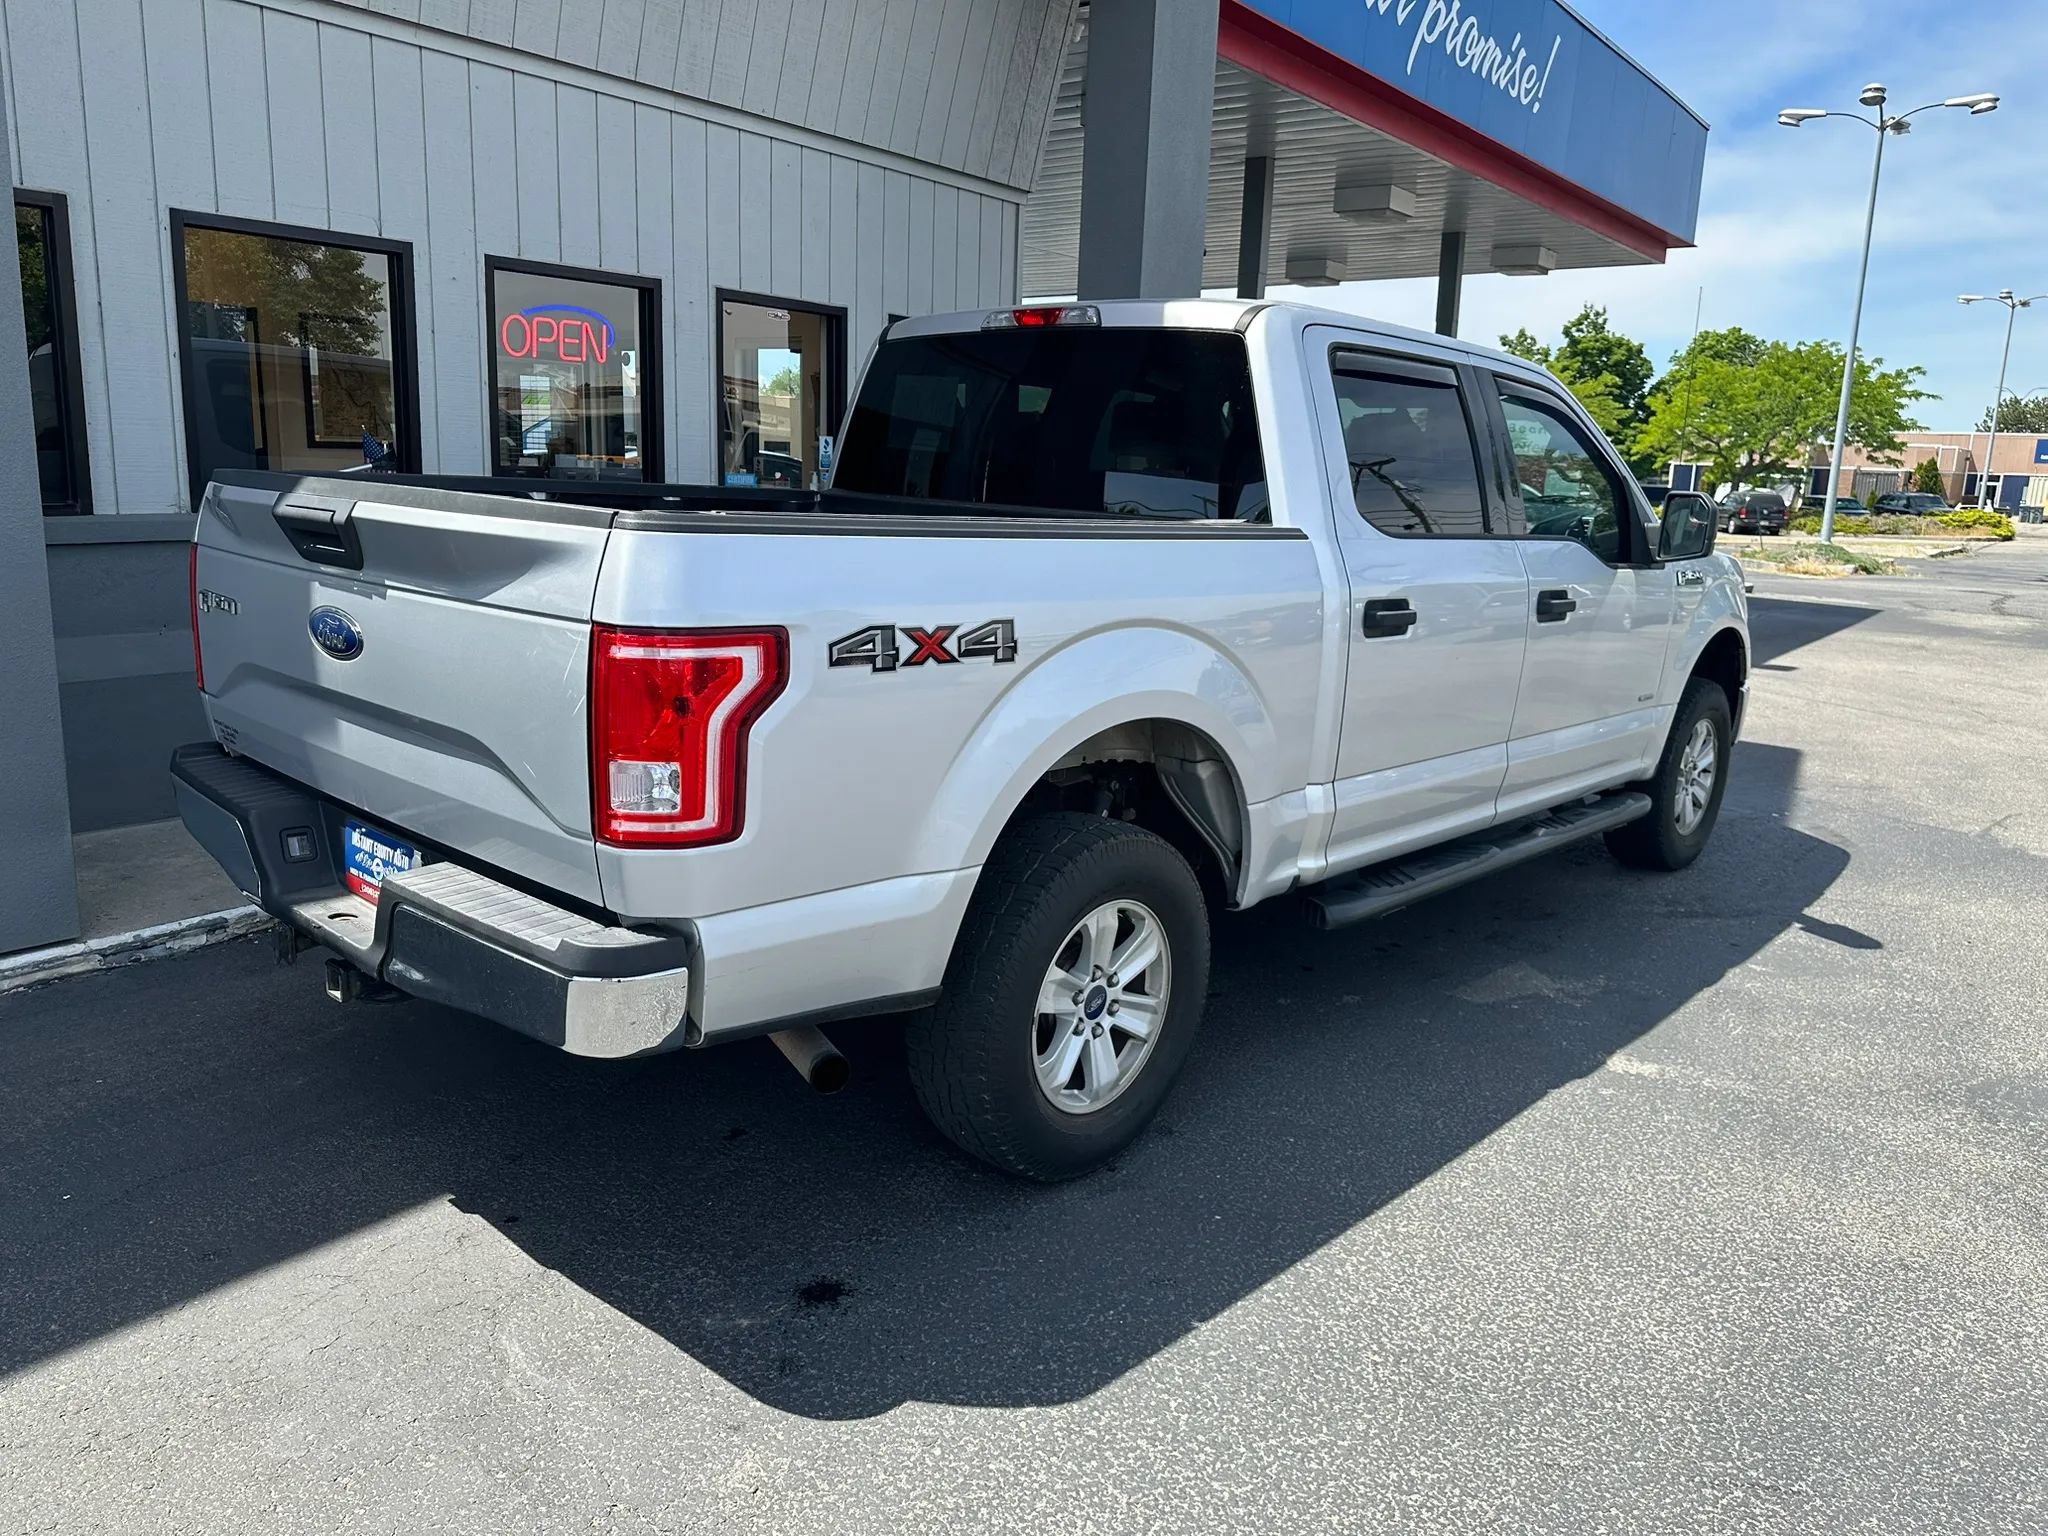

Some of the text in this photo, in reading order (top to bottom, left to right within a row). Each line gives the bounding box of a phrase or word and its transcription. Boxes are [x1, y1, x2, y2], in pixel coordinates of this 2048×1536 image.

[1406, 0, 1562, 114] promise!
[501, 313, 608, 363] OPEN
[827, 616, 1018, 675] 4X4
[351, 830, 374, 854] INSTANT
[373, 839, 394, 863] EQUITY
